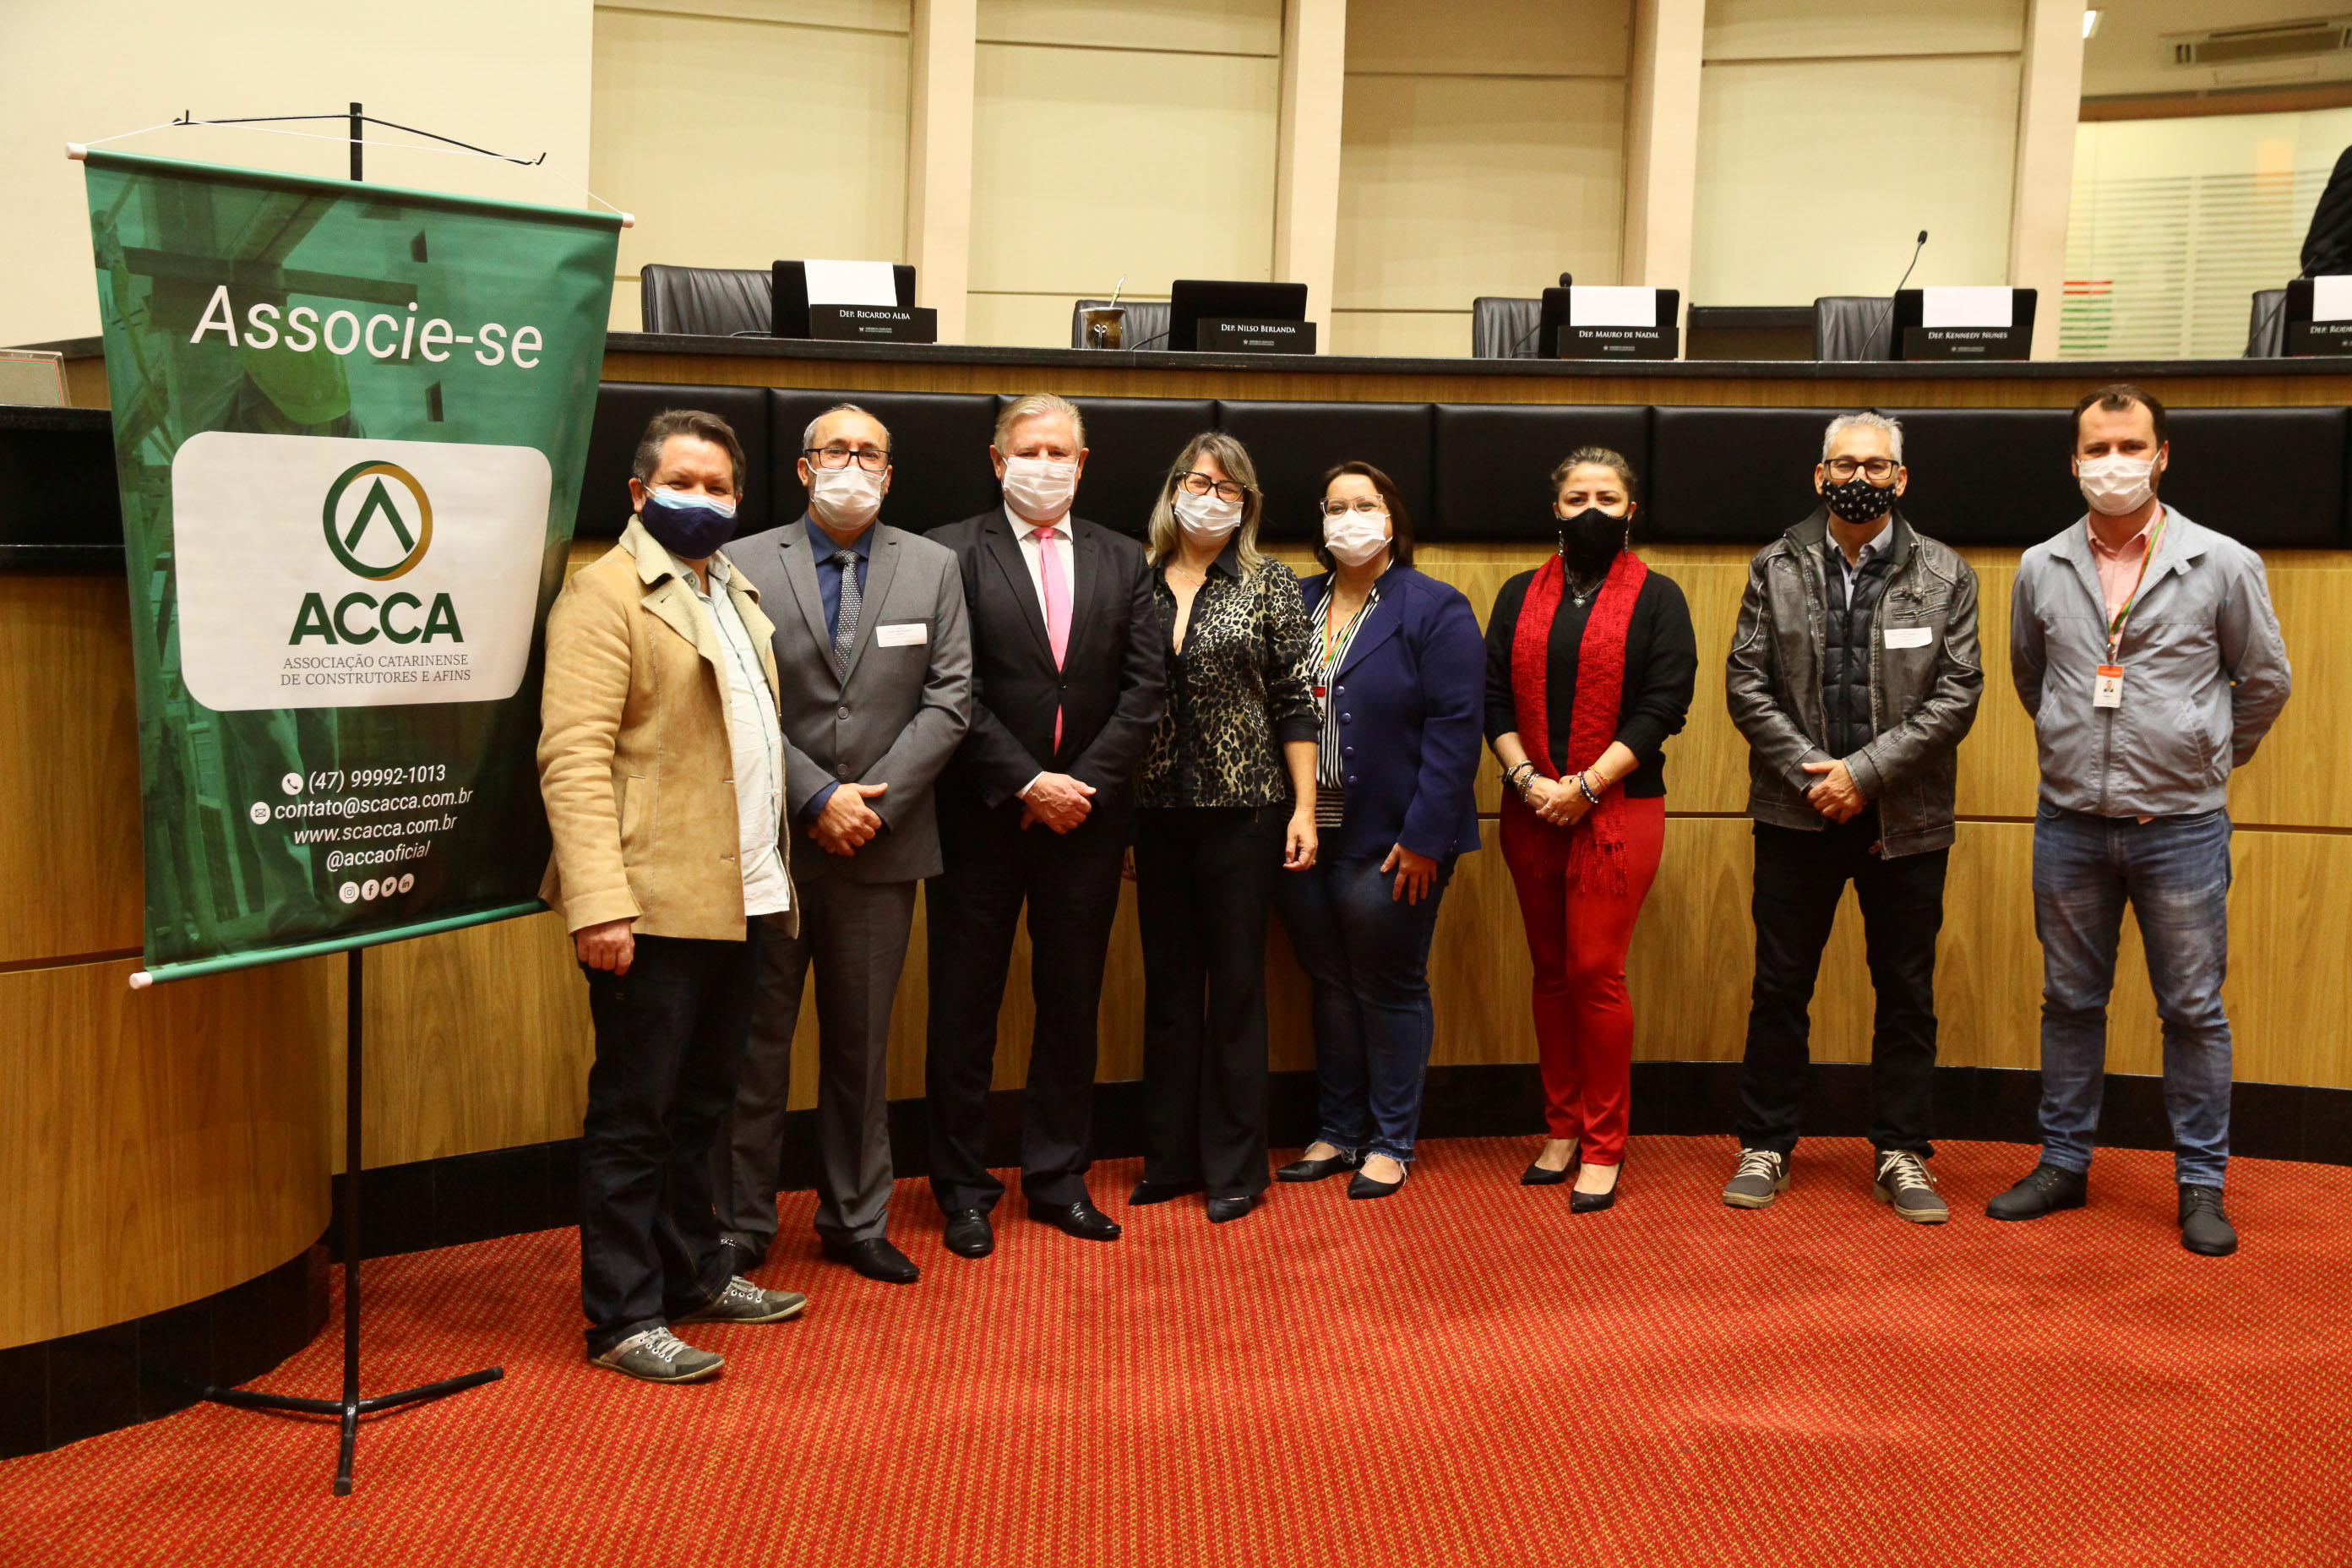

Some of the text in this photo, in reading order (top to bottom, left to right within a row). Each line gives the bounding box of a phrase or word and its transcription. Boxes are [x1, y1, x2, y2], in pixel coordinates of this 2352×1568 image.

[189, 285, 543, 369] Associe-se
[857, 310, 891, 319] RICARDO
[892, 312, 911, 320] ALBA
[1260, 325, 1296, 334] BERLANDA
[288, 591, 465, 645] ACCA
[283, 654, 469, 671] ASSOCIAÇÃO CATARINENSE
[280, 670, 471, 686] DE CONSTRUTORES E AFINS
[308, 764, 446, 794] (47) 99992-1013
[274, 787, 473, 820] contato@scacca.com.br
[294, 814, 458, 844] www.scacca.com.br
[326, 841, 431, 872] @accaoficial
